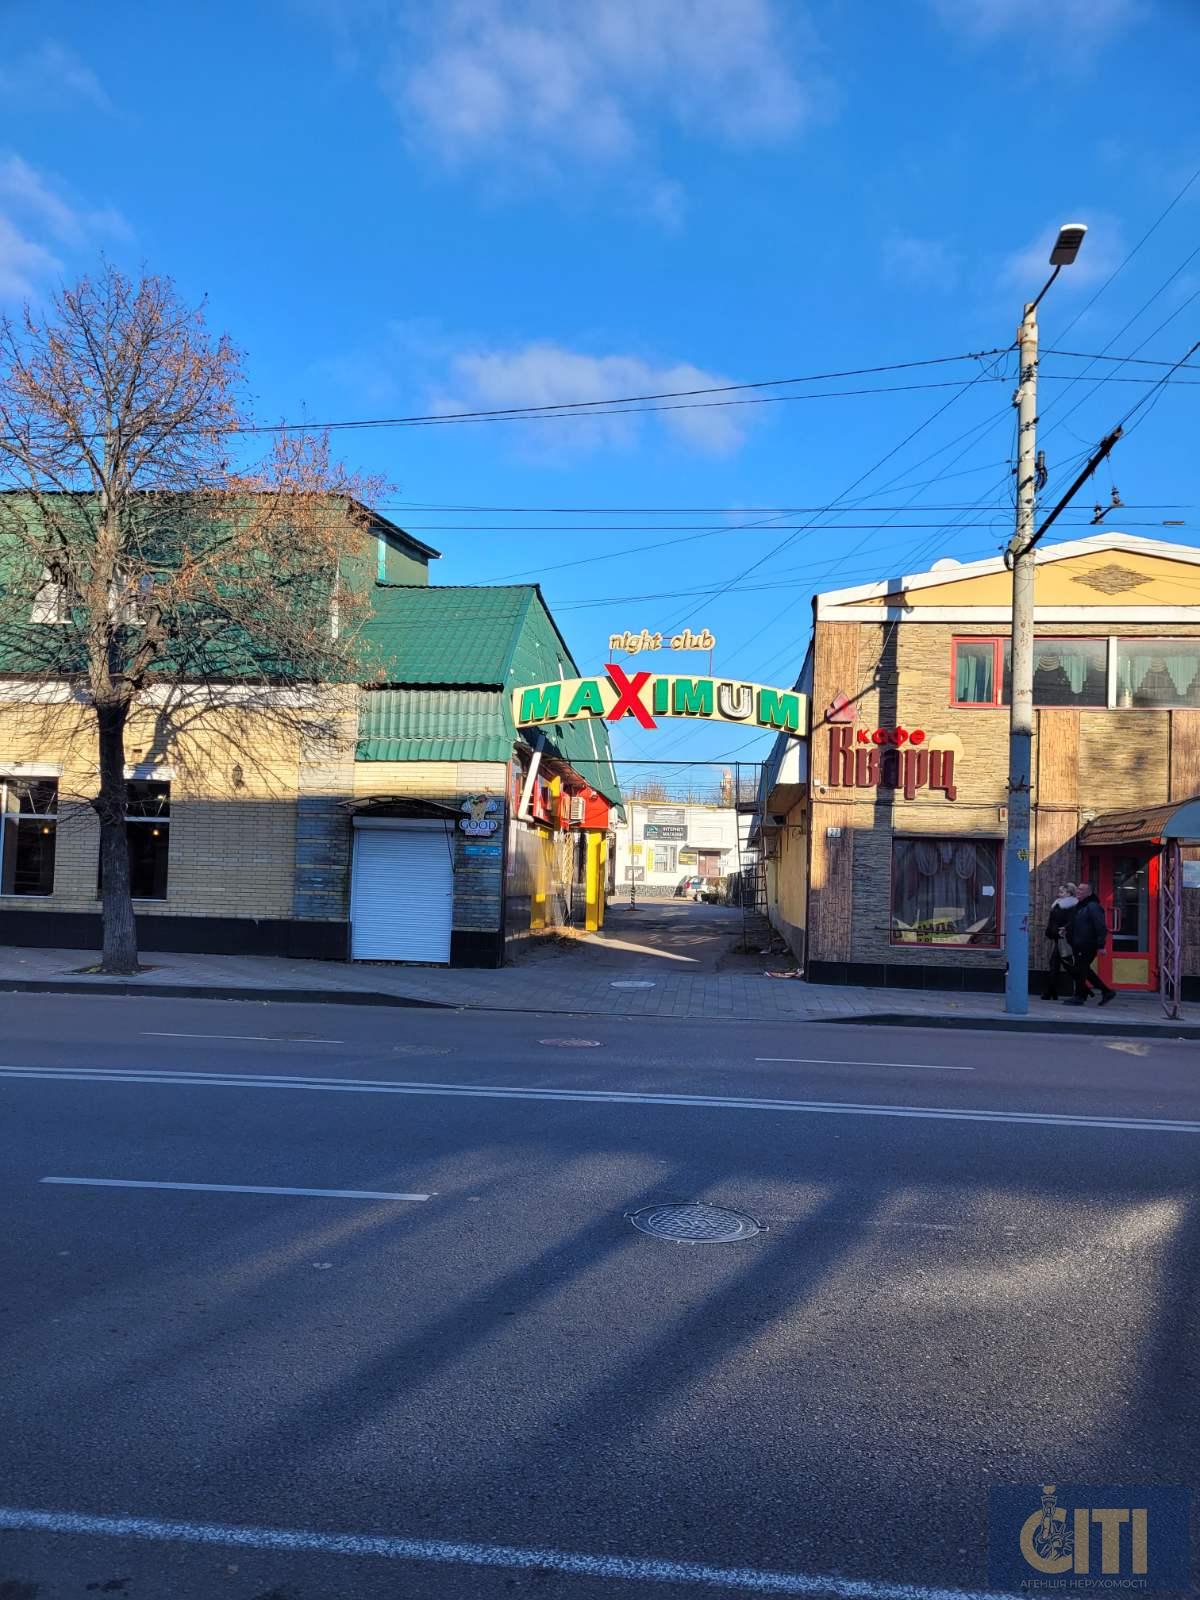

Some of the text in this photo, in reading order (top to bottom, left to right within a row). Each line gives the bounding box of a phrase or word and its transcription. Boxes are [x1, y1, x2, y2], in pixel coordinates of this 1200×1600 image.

[609, 628, 715, 655] night club
[519, 663, 800, 730] MAXIMUM
[828, 726, 957, 801] Кварц
[459, 819, 498, 830] GOOD
